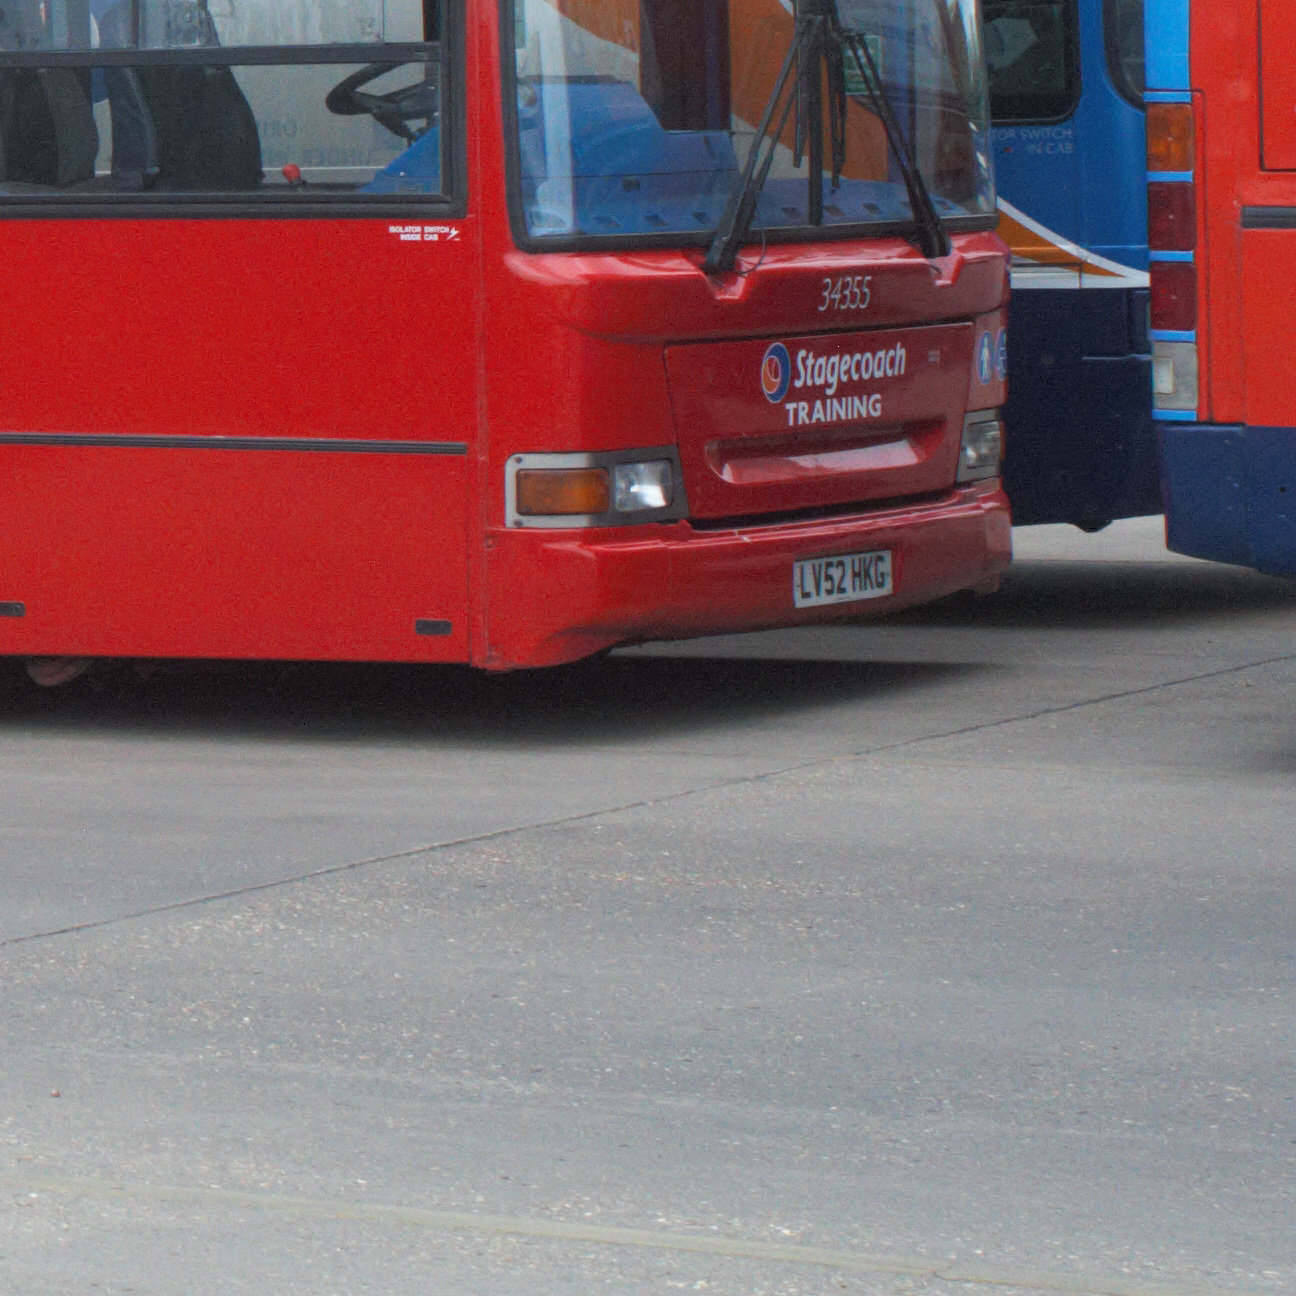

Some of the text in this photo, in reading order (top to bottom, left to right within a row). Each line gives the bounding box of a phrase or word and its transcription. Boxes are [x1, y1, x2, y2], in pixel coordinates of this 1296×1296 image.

[818, 275, 872, 312] 34355
[794, 342, 907, 396] Stagecoach
[785, 393, 882, 427] TRAINING
[799, 554, 886, 599] LV52 HKG
